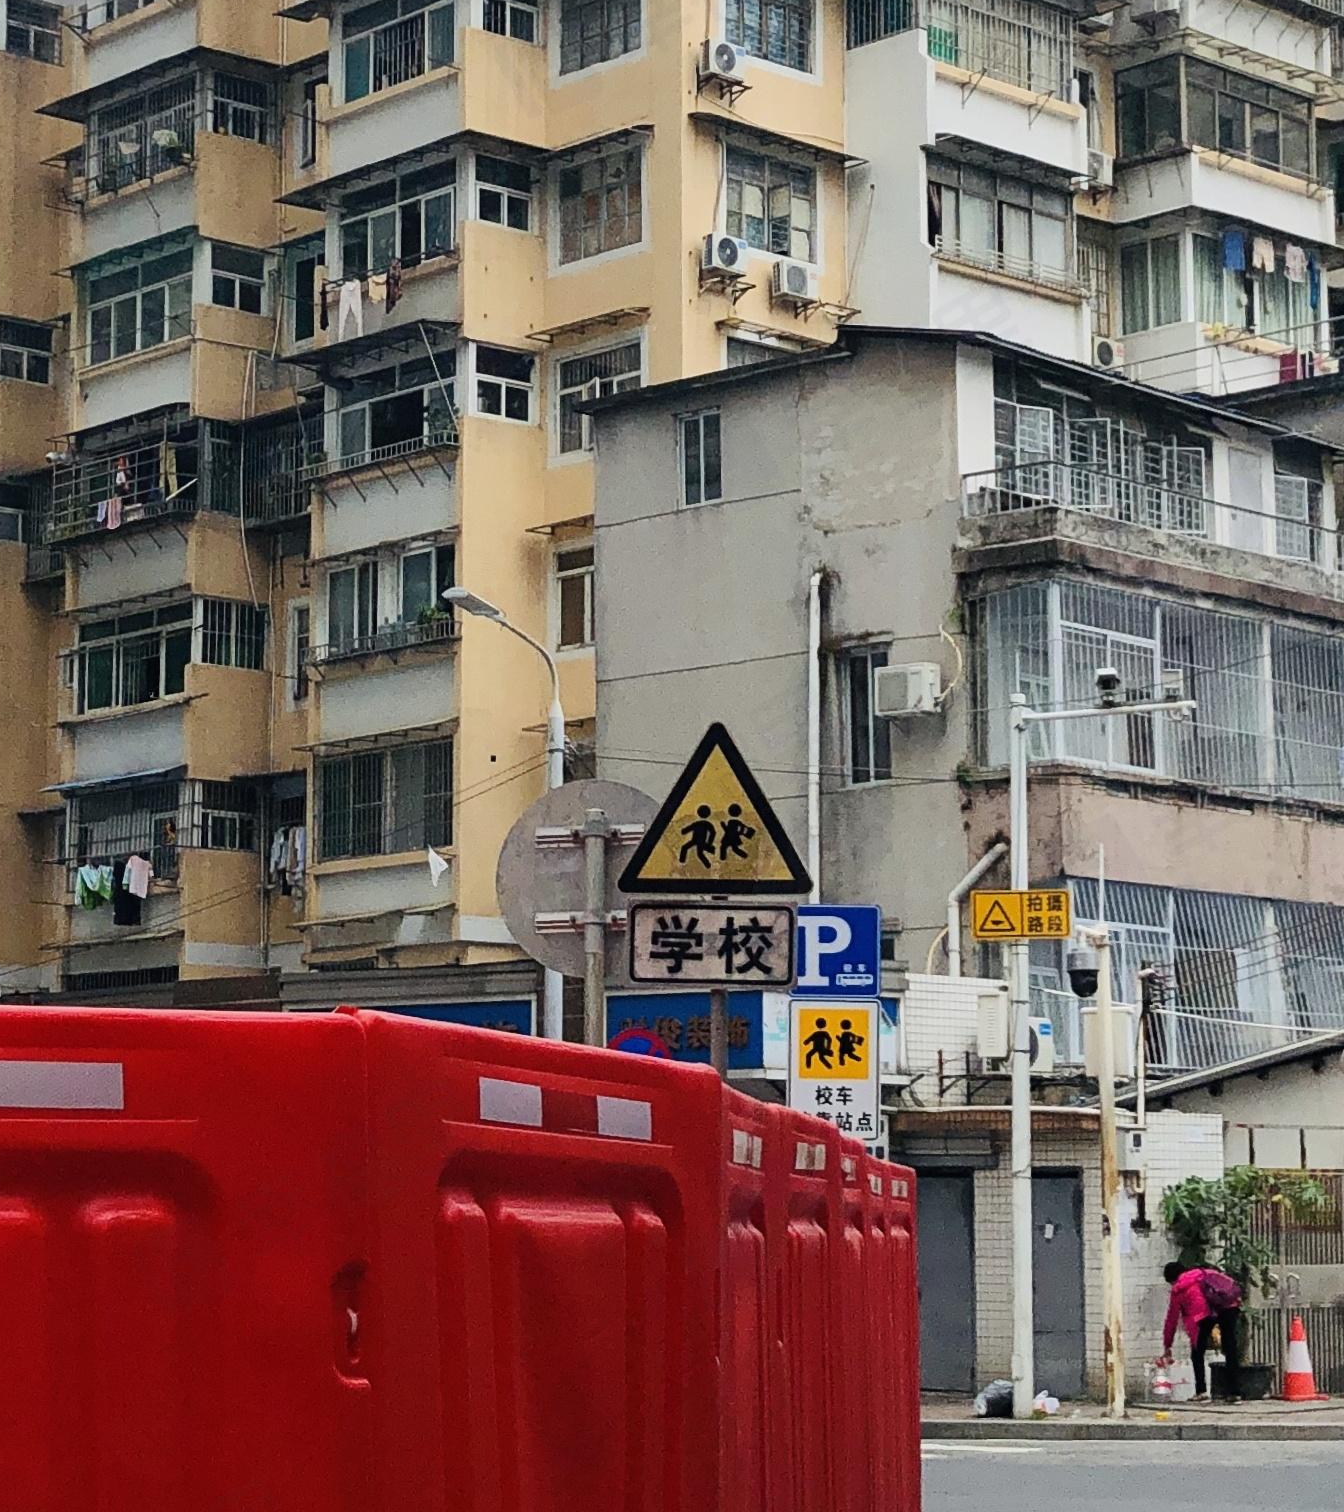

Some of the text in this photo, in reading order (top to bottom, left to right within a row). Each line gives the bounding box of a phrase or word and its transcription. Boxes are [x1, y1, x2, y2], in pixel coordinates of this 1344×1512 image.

[1027, 895, 1062, 912] 拍摄
[1027, 916, 1063, 932] 路段
[649, 915, 773, 975] 学校
[797, 915, 852, 987] P
[815, 1085, 853, 1106] 校车
